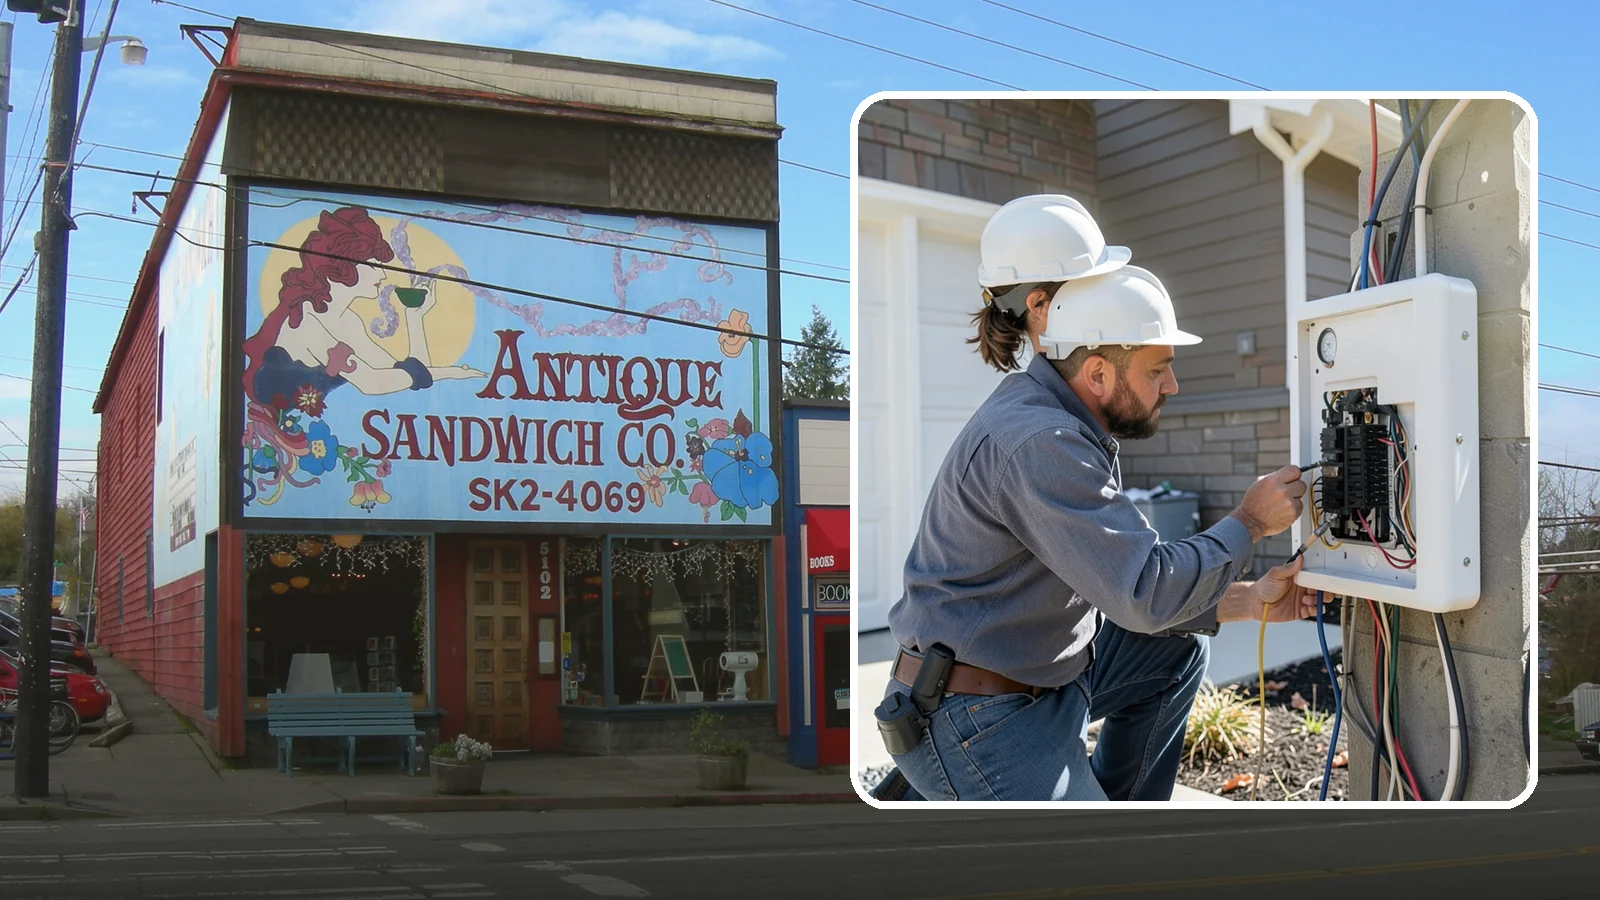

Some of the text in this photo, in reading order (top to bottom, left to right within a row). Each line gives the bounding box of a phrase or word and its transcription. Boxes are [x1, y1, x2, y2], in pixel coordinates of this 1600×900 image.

[476, 329, 724, 420] ANTIQUE
[360, 409, 685, 468] SANDWICH CO.
[468, 478, 646, 513] SK2-4069
[540, 542, 552, 600] 5102
[809, 555, 835, 569] BOOKS
